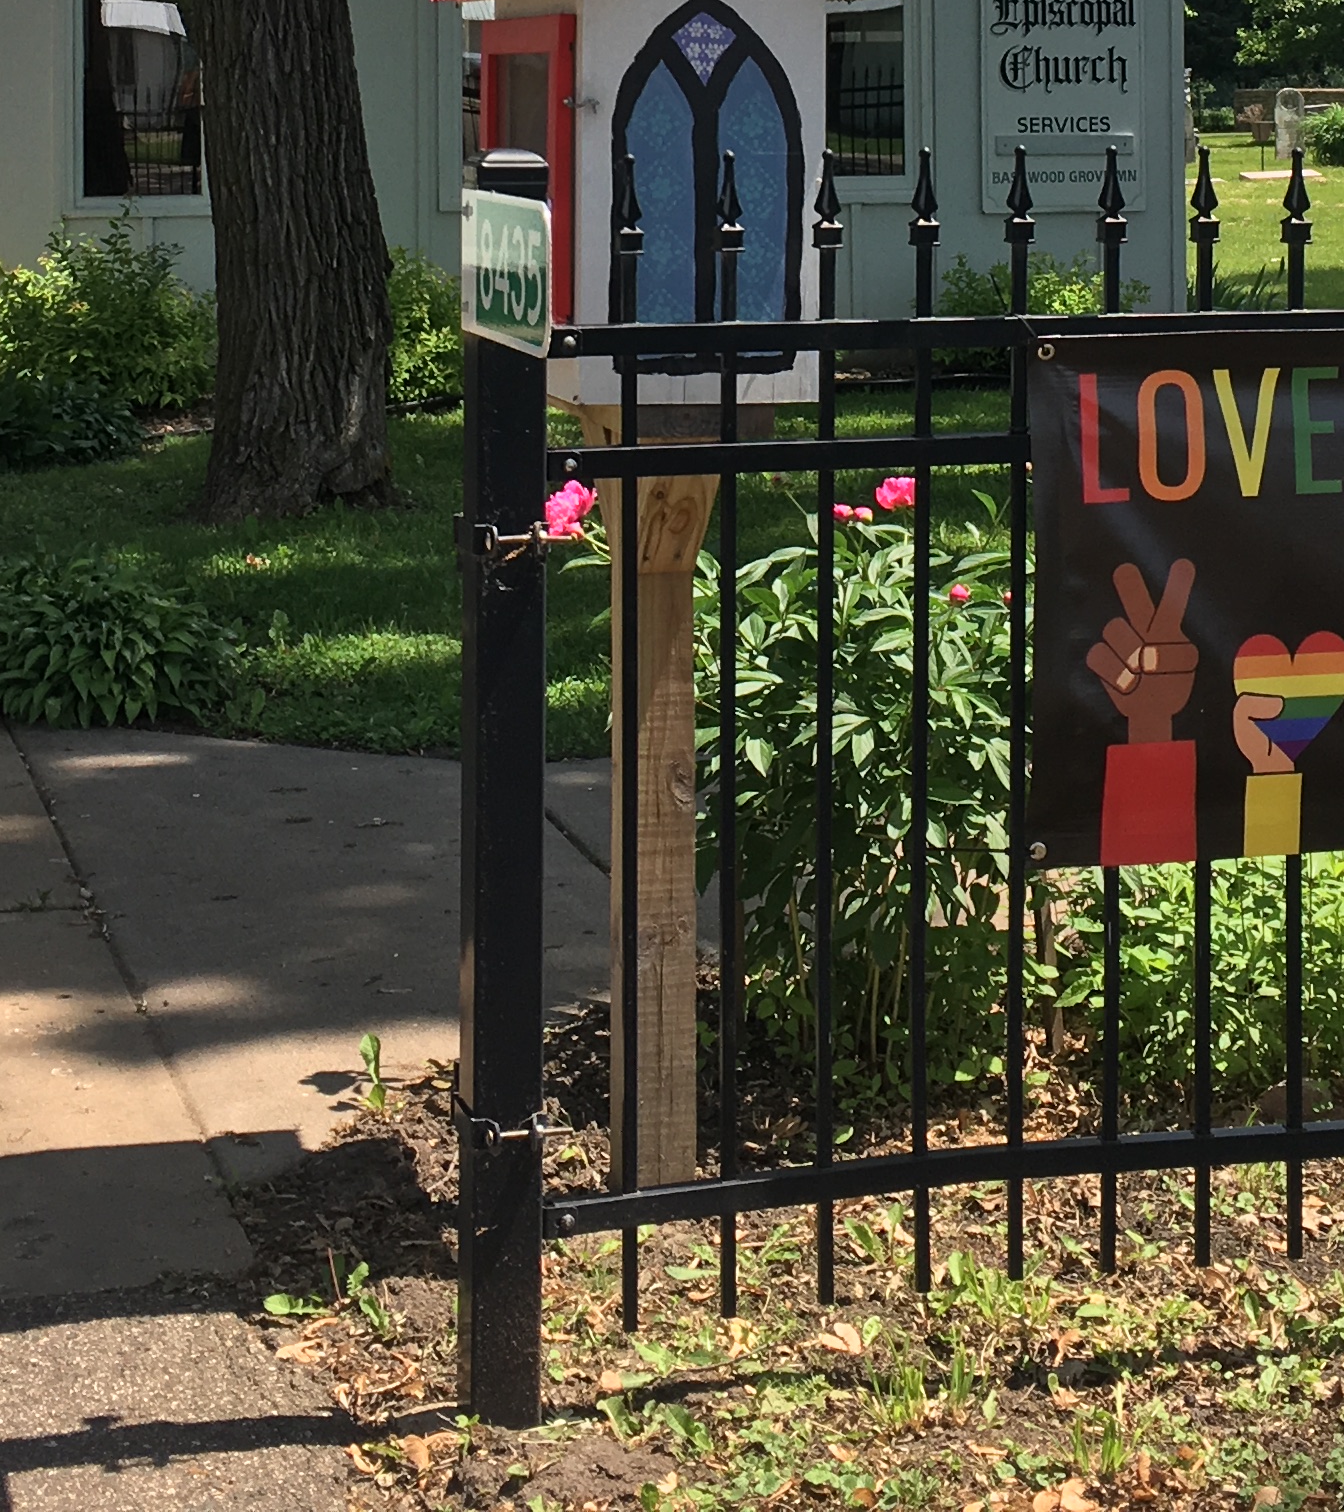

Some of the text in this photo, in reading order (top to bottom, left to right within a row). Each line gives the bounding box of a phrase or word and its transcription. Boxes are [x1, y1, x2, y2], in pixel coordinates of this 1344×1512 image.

[999, 45, 1129, 93] Church
[1017, 116, 1111, 134] SERVICES
[992, 171, 1065, 184] BASWOOD
[1069, 171, 1105, 183] GROV
[480, 218, 542, 326] 8435
[1078, 366, 1343, 506] LOVE
